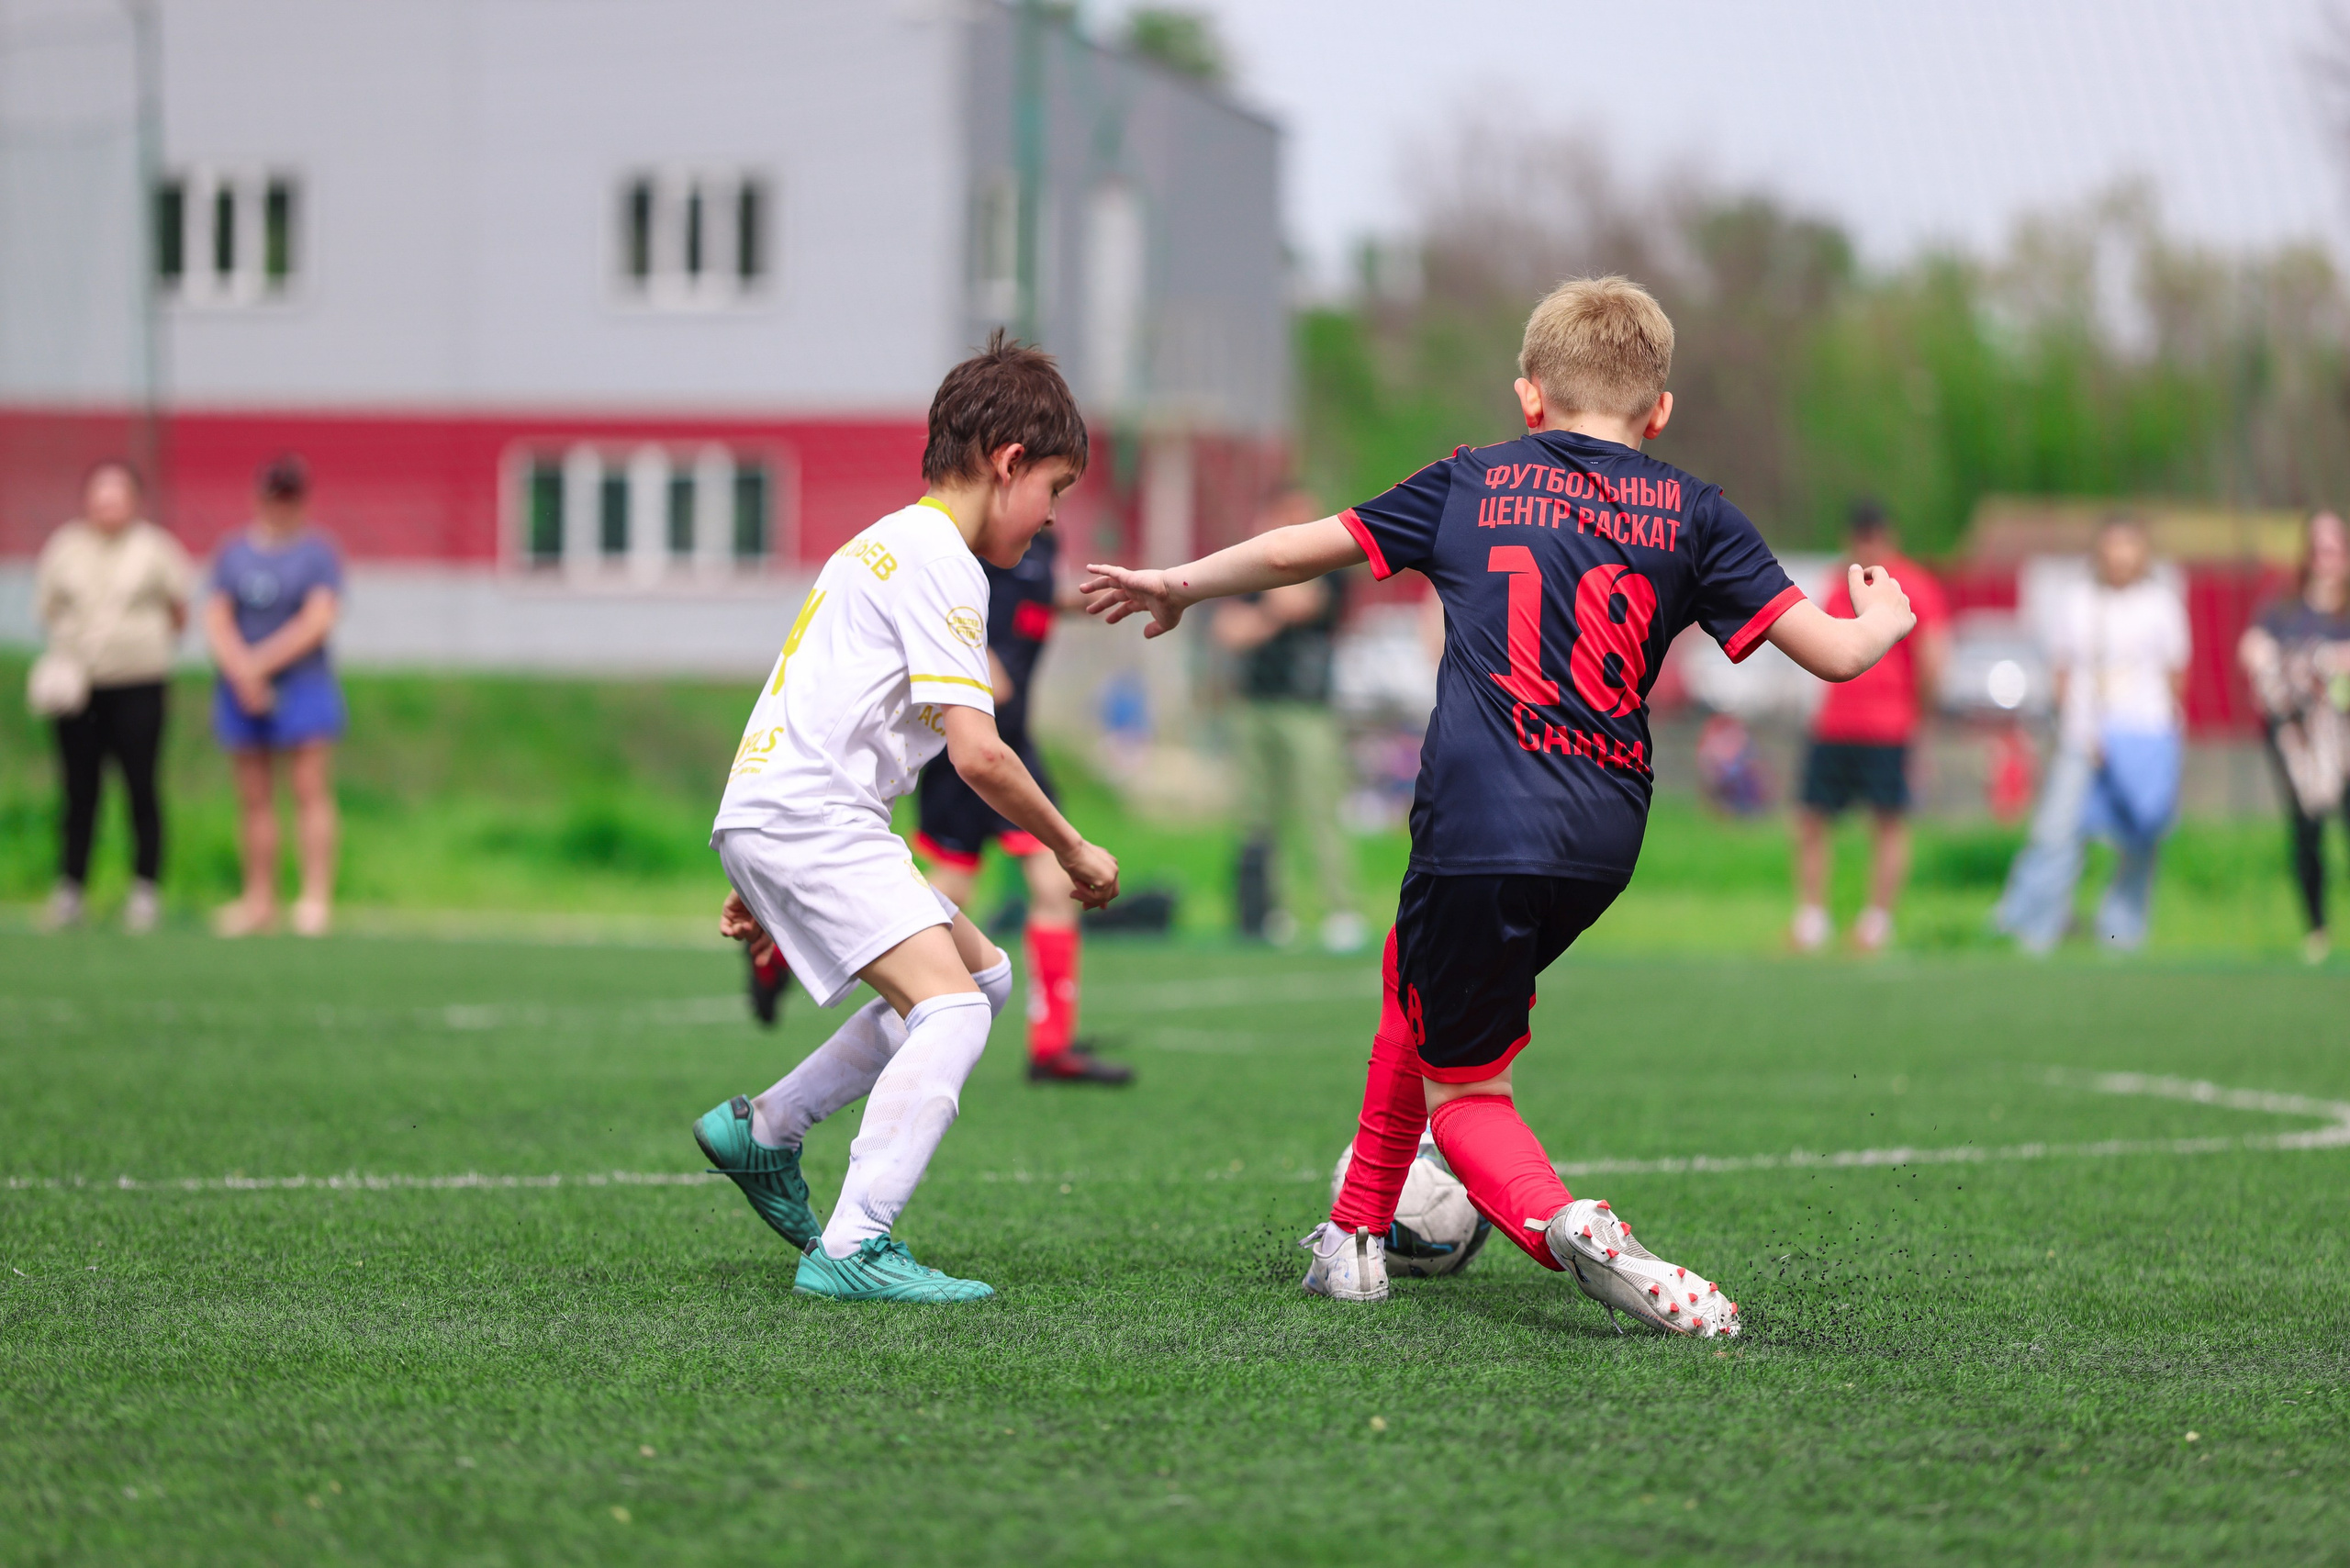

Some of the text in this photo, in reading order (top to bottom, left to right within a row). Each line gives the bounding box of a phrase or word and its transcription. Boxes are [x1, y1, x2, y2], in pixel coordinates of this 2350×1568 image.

[1484, 463, 1682, 513] ФУТБОЛЬНЫЙ
[1477, 496, 1681, 553] ЦЕНТР РАСКАТ
[1487, 545, 1657, 718] 18
